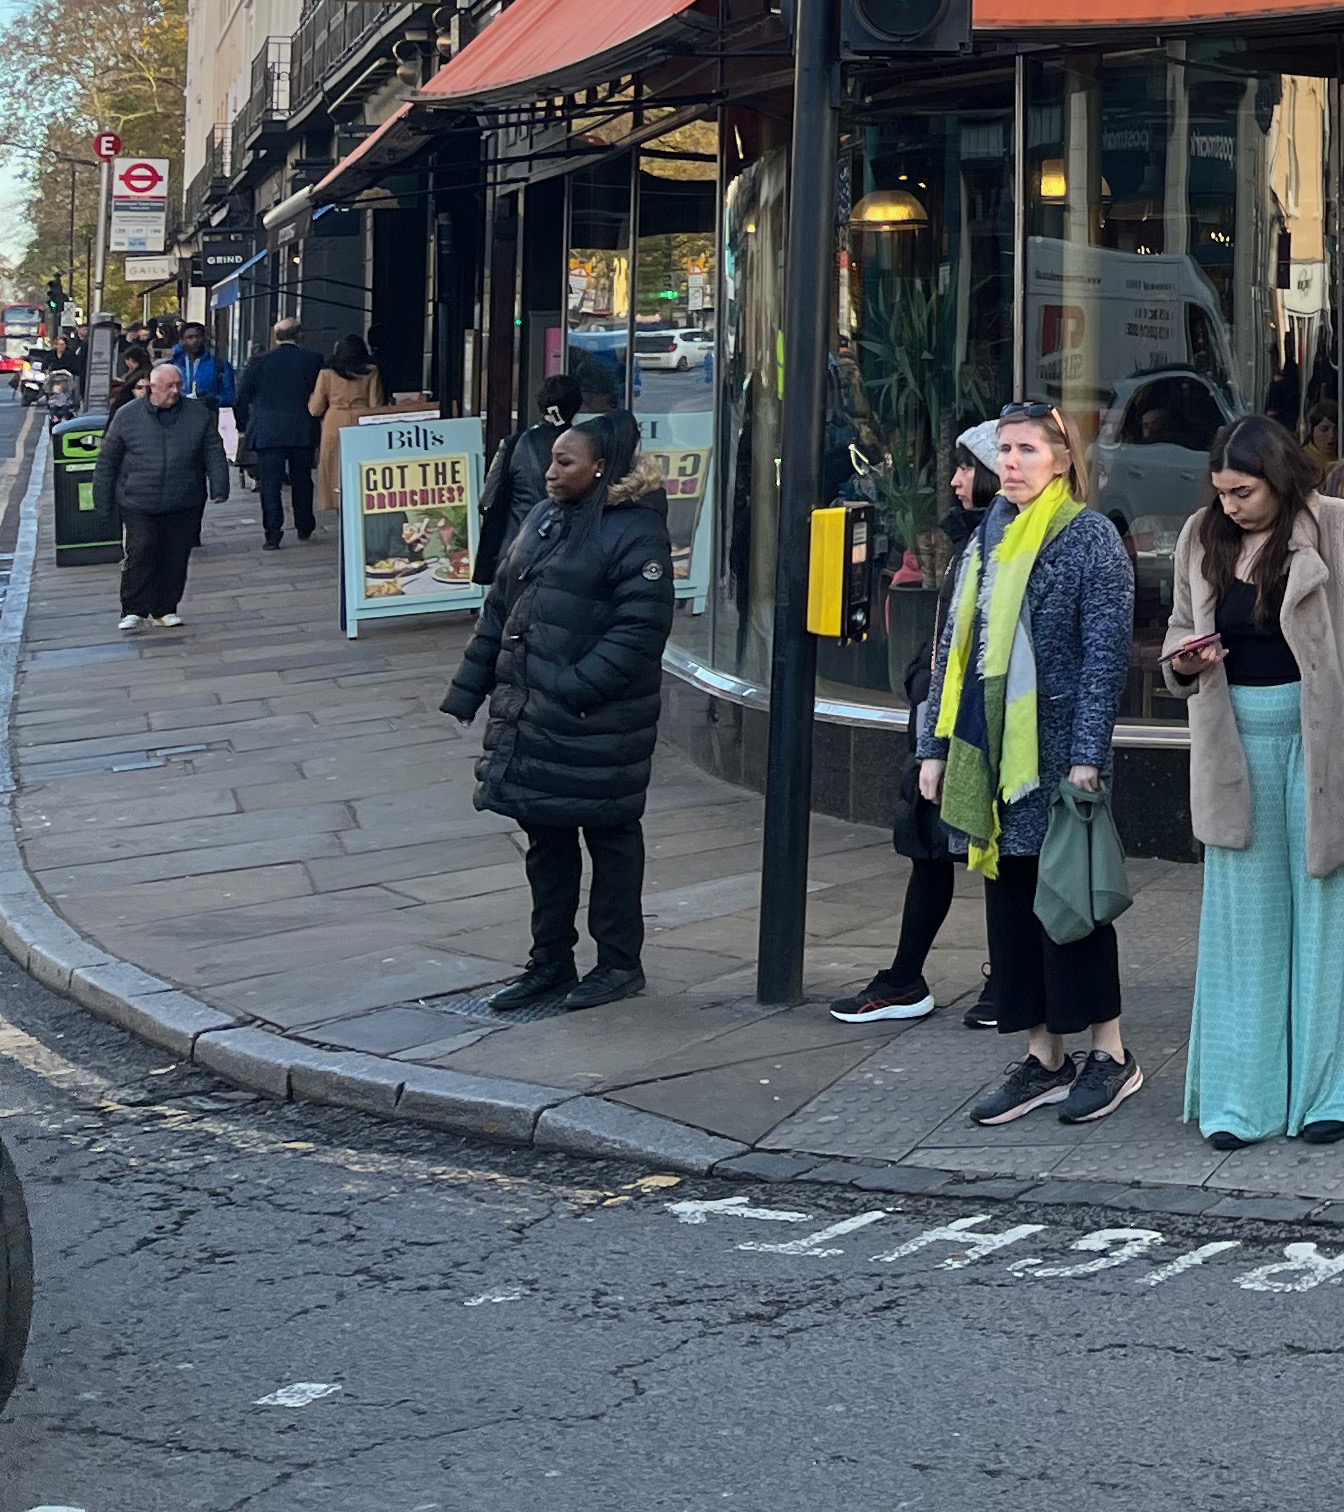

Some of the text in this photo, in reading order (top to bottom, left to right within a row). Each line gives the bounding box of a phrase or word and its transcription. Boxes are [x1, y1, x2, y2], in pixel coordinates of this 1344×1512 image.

[101, 136, 115, 155] E
[206, 255, 243, 265] GRIND
[387, 425, 445, 451] Bill's
[365, 460, 462, 492] GOT THE
[365, 485, 465, 510] BRUNCHIES?
